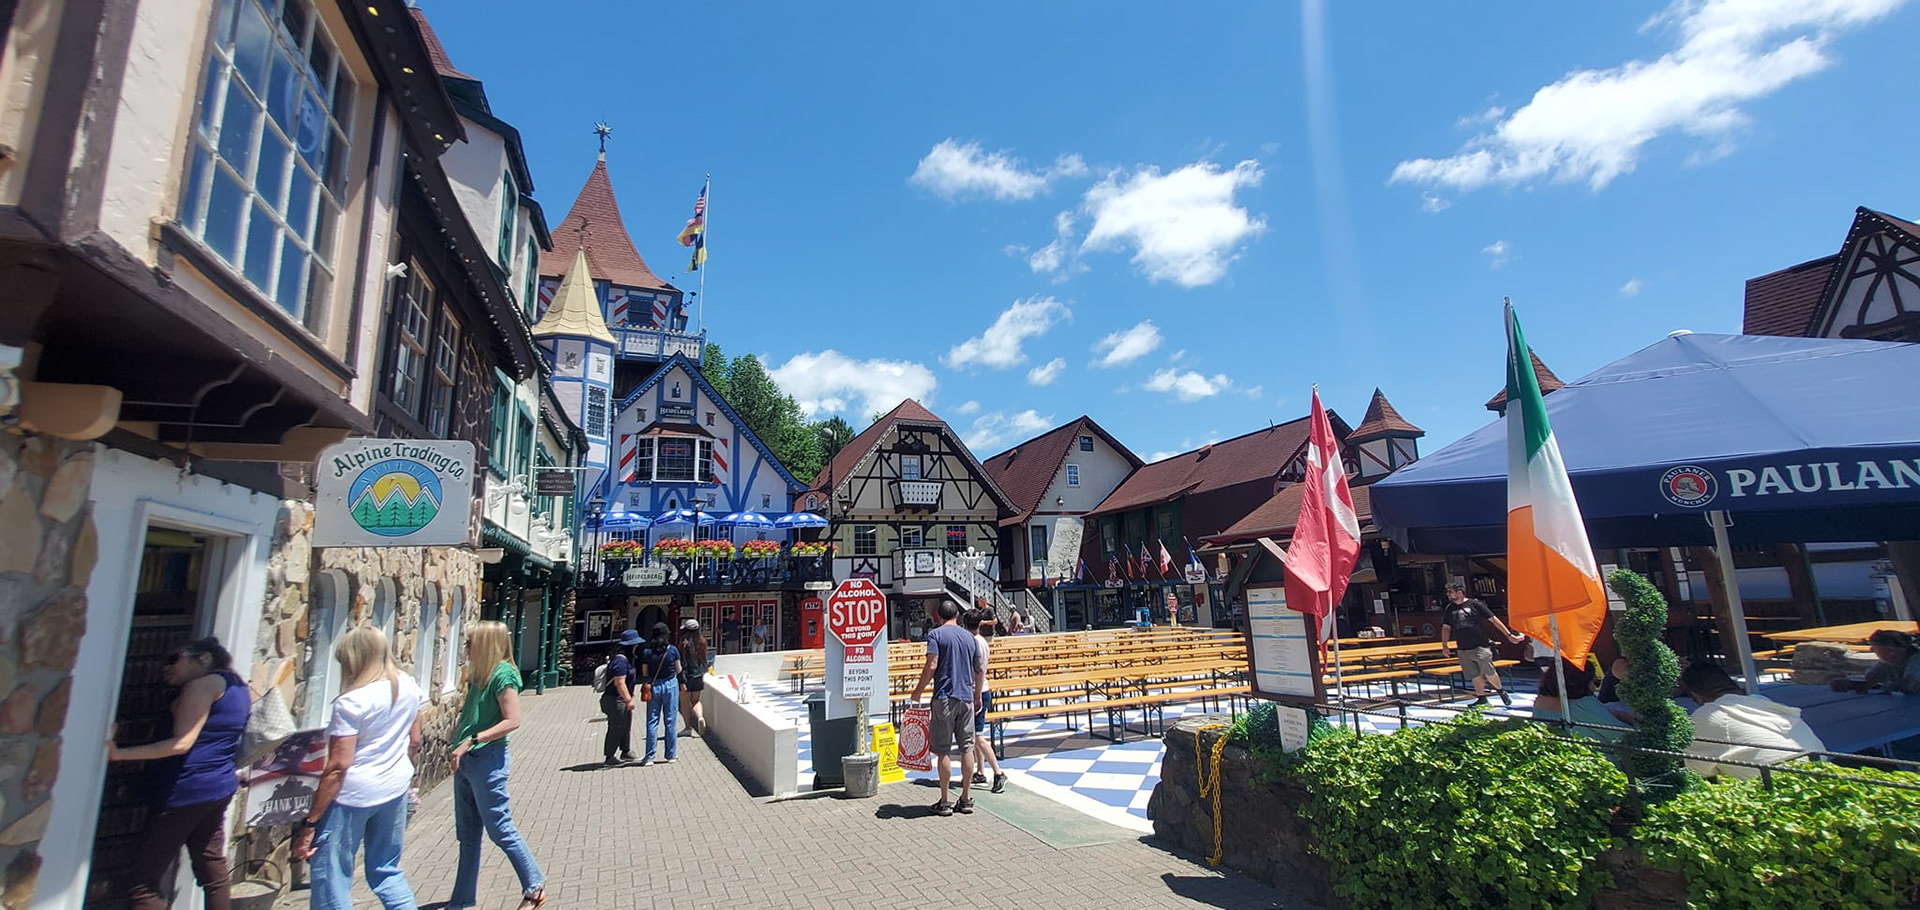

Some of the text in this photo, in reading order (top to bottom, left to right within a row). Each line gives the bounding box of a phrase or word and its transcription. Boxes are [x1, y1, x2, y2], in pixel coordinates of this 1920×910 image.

[334, 442, 465, 480] Alpine Trading Co.
[1664, 467, 1711, 484] PAULANER
[626, 572, 663, 582] HEIDELBERG
[837, 589, 876, 598] ALCOHOL
[832, 599, 882, 626] STOP
[845, 625, 871, 633] BEYOND
[841, 631, 876, 640] THIS POINT
[846, 655, 873, 663] ALCOHOL
